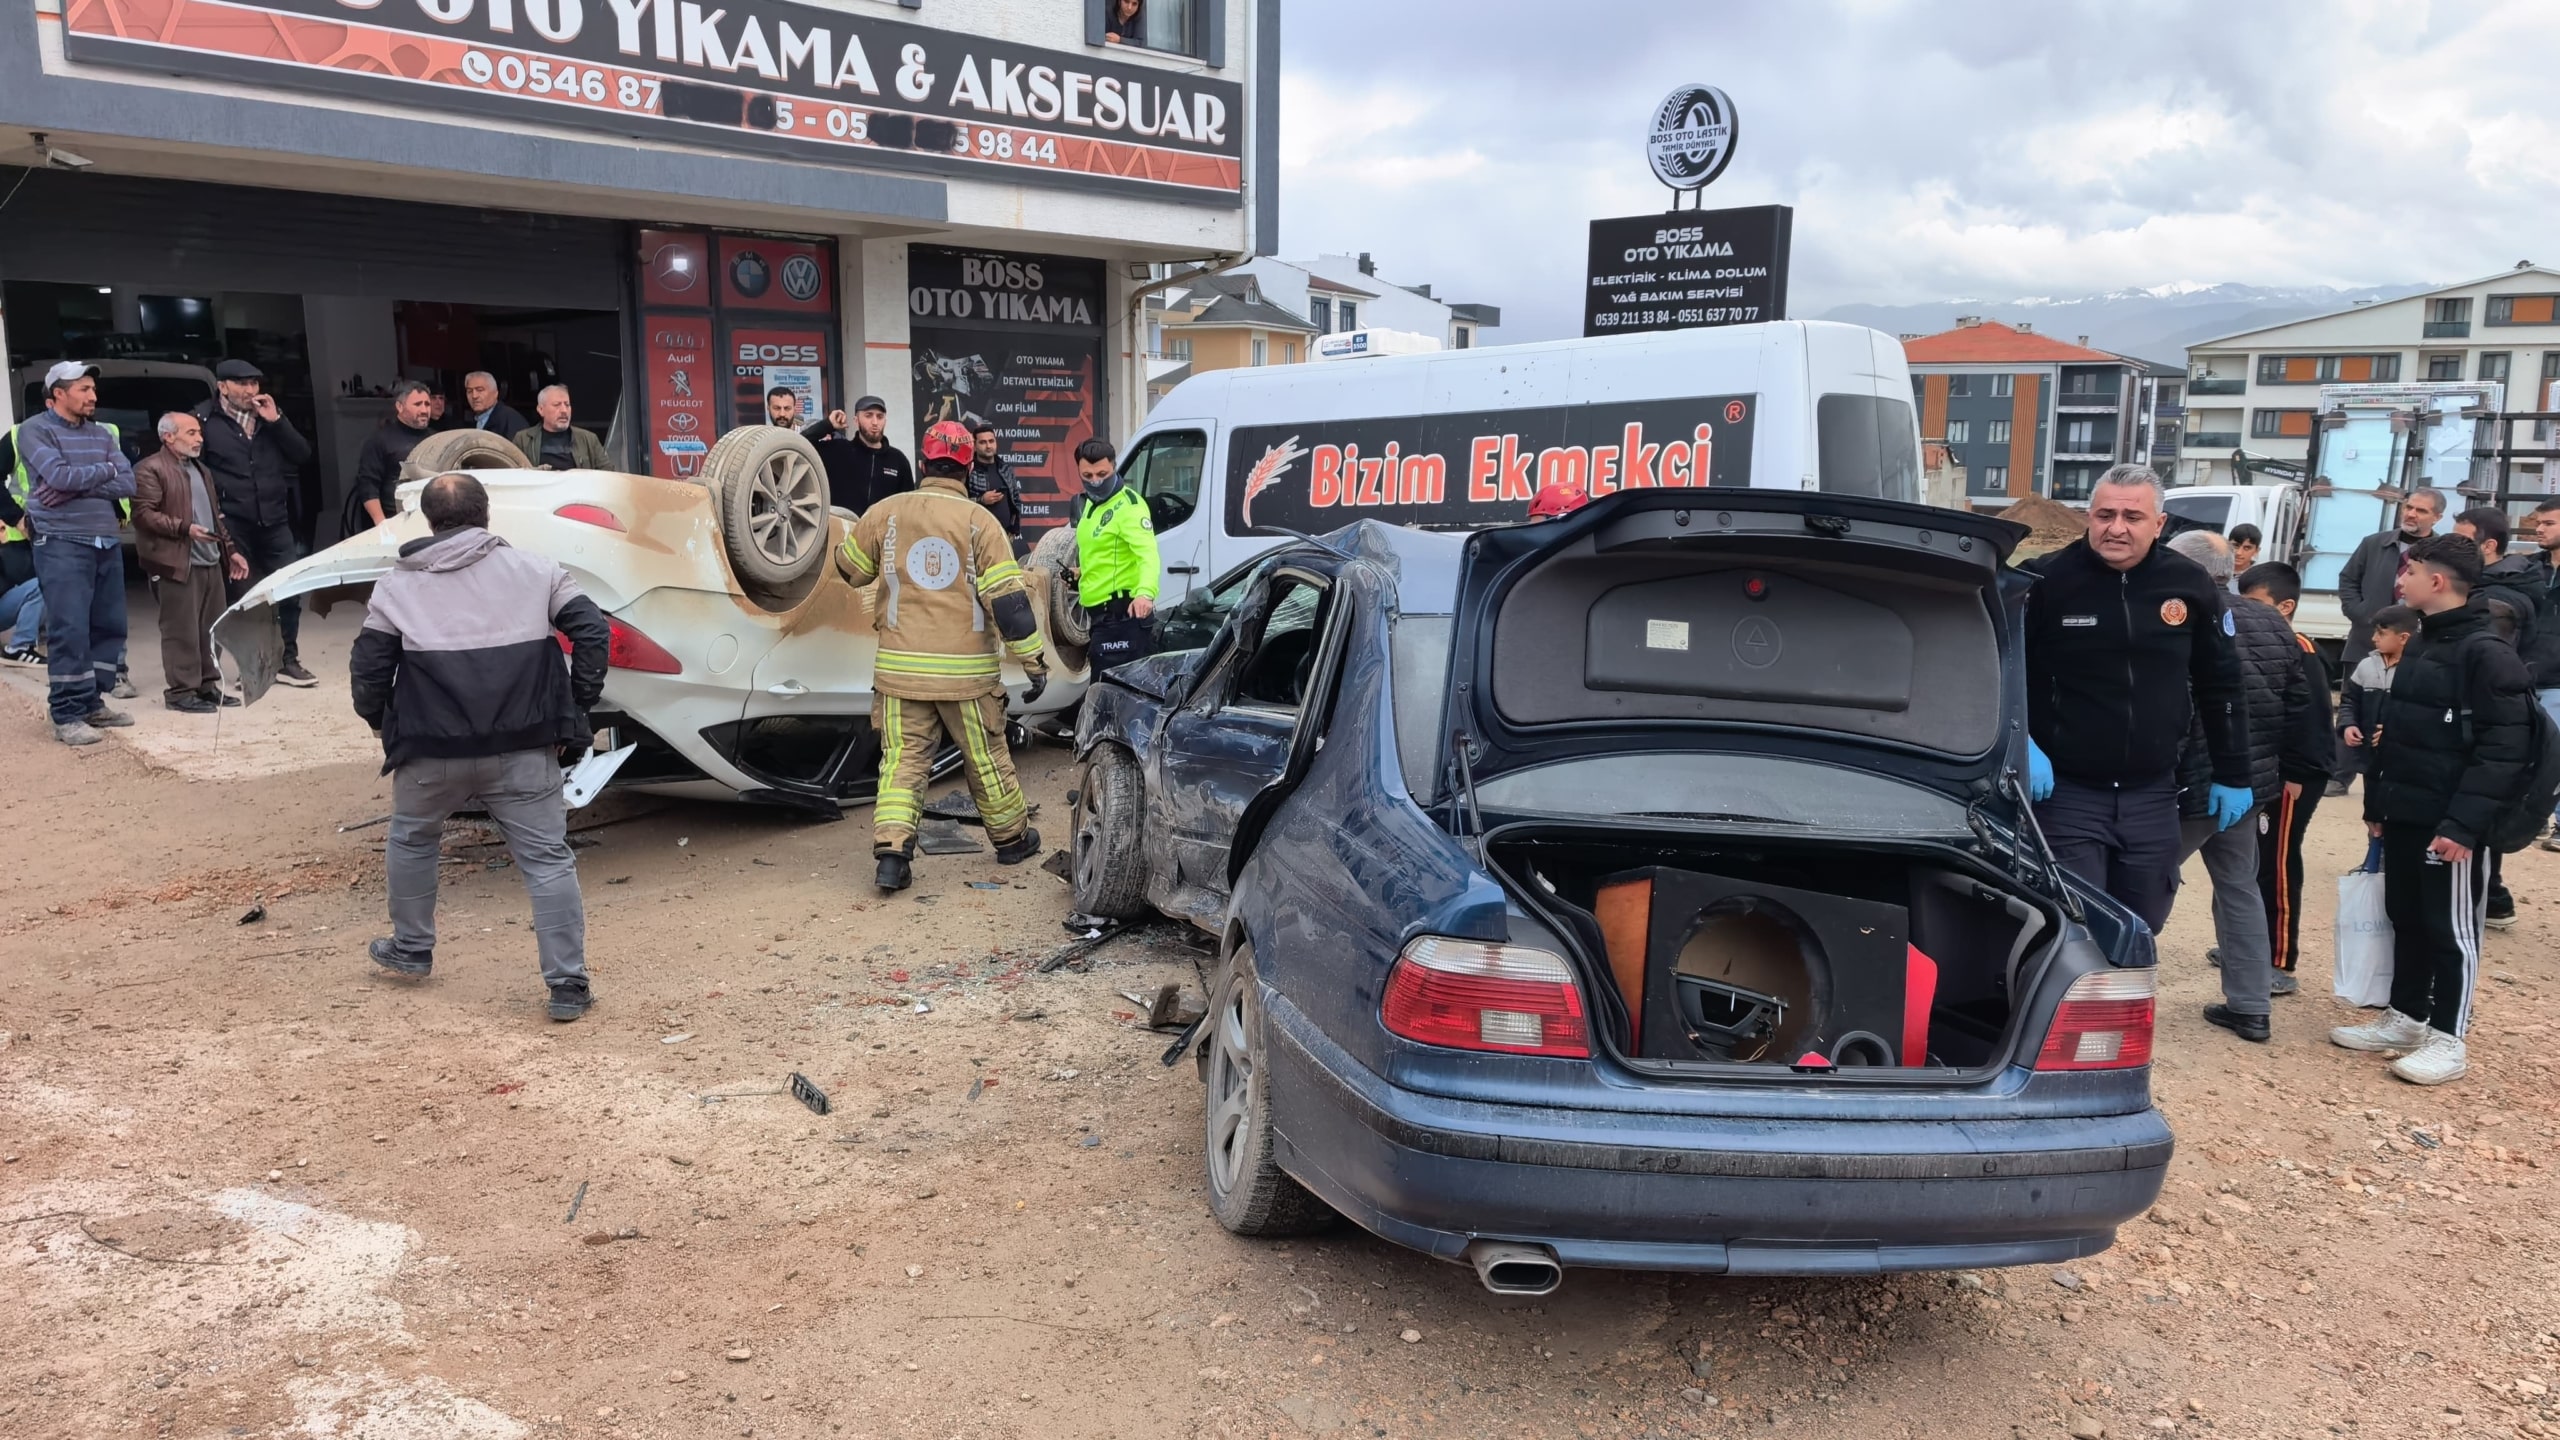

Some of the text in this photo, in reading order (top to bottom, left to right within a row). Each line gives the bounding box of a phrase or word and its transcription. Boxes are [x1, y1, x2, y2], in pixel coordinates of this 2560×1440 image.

[608, 0, 881, 96] YIKAMA
[895, 43, 935, 102] &
[948, 54, 1226, 146] AKSESUAR
[497, 55, 607, 102] 0546
[978, 129, 1013, 159] 98
[1020, 136, 1057, 164] 44
[1650, 127, 1728, 144] BOSS OTO LASTİK
[1662, 143, 1684, 152] TAMİR
[1655, 227, 1704, 244] BOSS
[1624, 241, 1734, 262] OTO YIKAMA
[963, 258, 1044, 290] BOSS
[1592, 271, 1657, 286] ELEKTİRİK
[1668, 268, 1712, 282] KLİMA
[1715, 267, 1767, 279] DOLUM
[1611, 285, 1744, 303] YAĞ BAKIM SERVİSİ
[910, 286, 1092, 325] OTO YIKAMA
[1595, 312, 1619, 327] 0539
[1621, 311, 1640, 325] 211
[1642, 310, 1654, 324] 33
[1656, 309, 1670, 323] 84
[1678, 308, 1704, 323] 0551
[1706, 308, 1726, 321] 637
[1729, 307, 1743, 320] 70
[1745, 306, 1760, 320] 77
[667, 353, 695, 363] Audi
[739, 344, 819, 362] BOSS
[1016, 355, 1065, 366] OTO YIKAMA
[736, 366, 763, 376] OTO
[1002, 376, 1074, 388] DETAYLI TEMİZLİK
[660, 400, 704, 408] PEUGEOT
[995, 402, 1037, 413] CAM FİLMİ
[993, 429, 1041, 438] YA KORUMA
[1310, 441, 1446, 508] Bizim
[1021, 504, 1050, 514] İZLEME
[884, 514, 897, 575] BURSA
